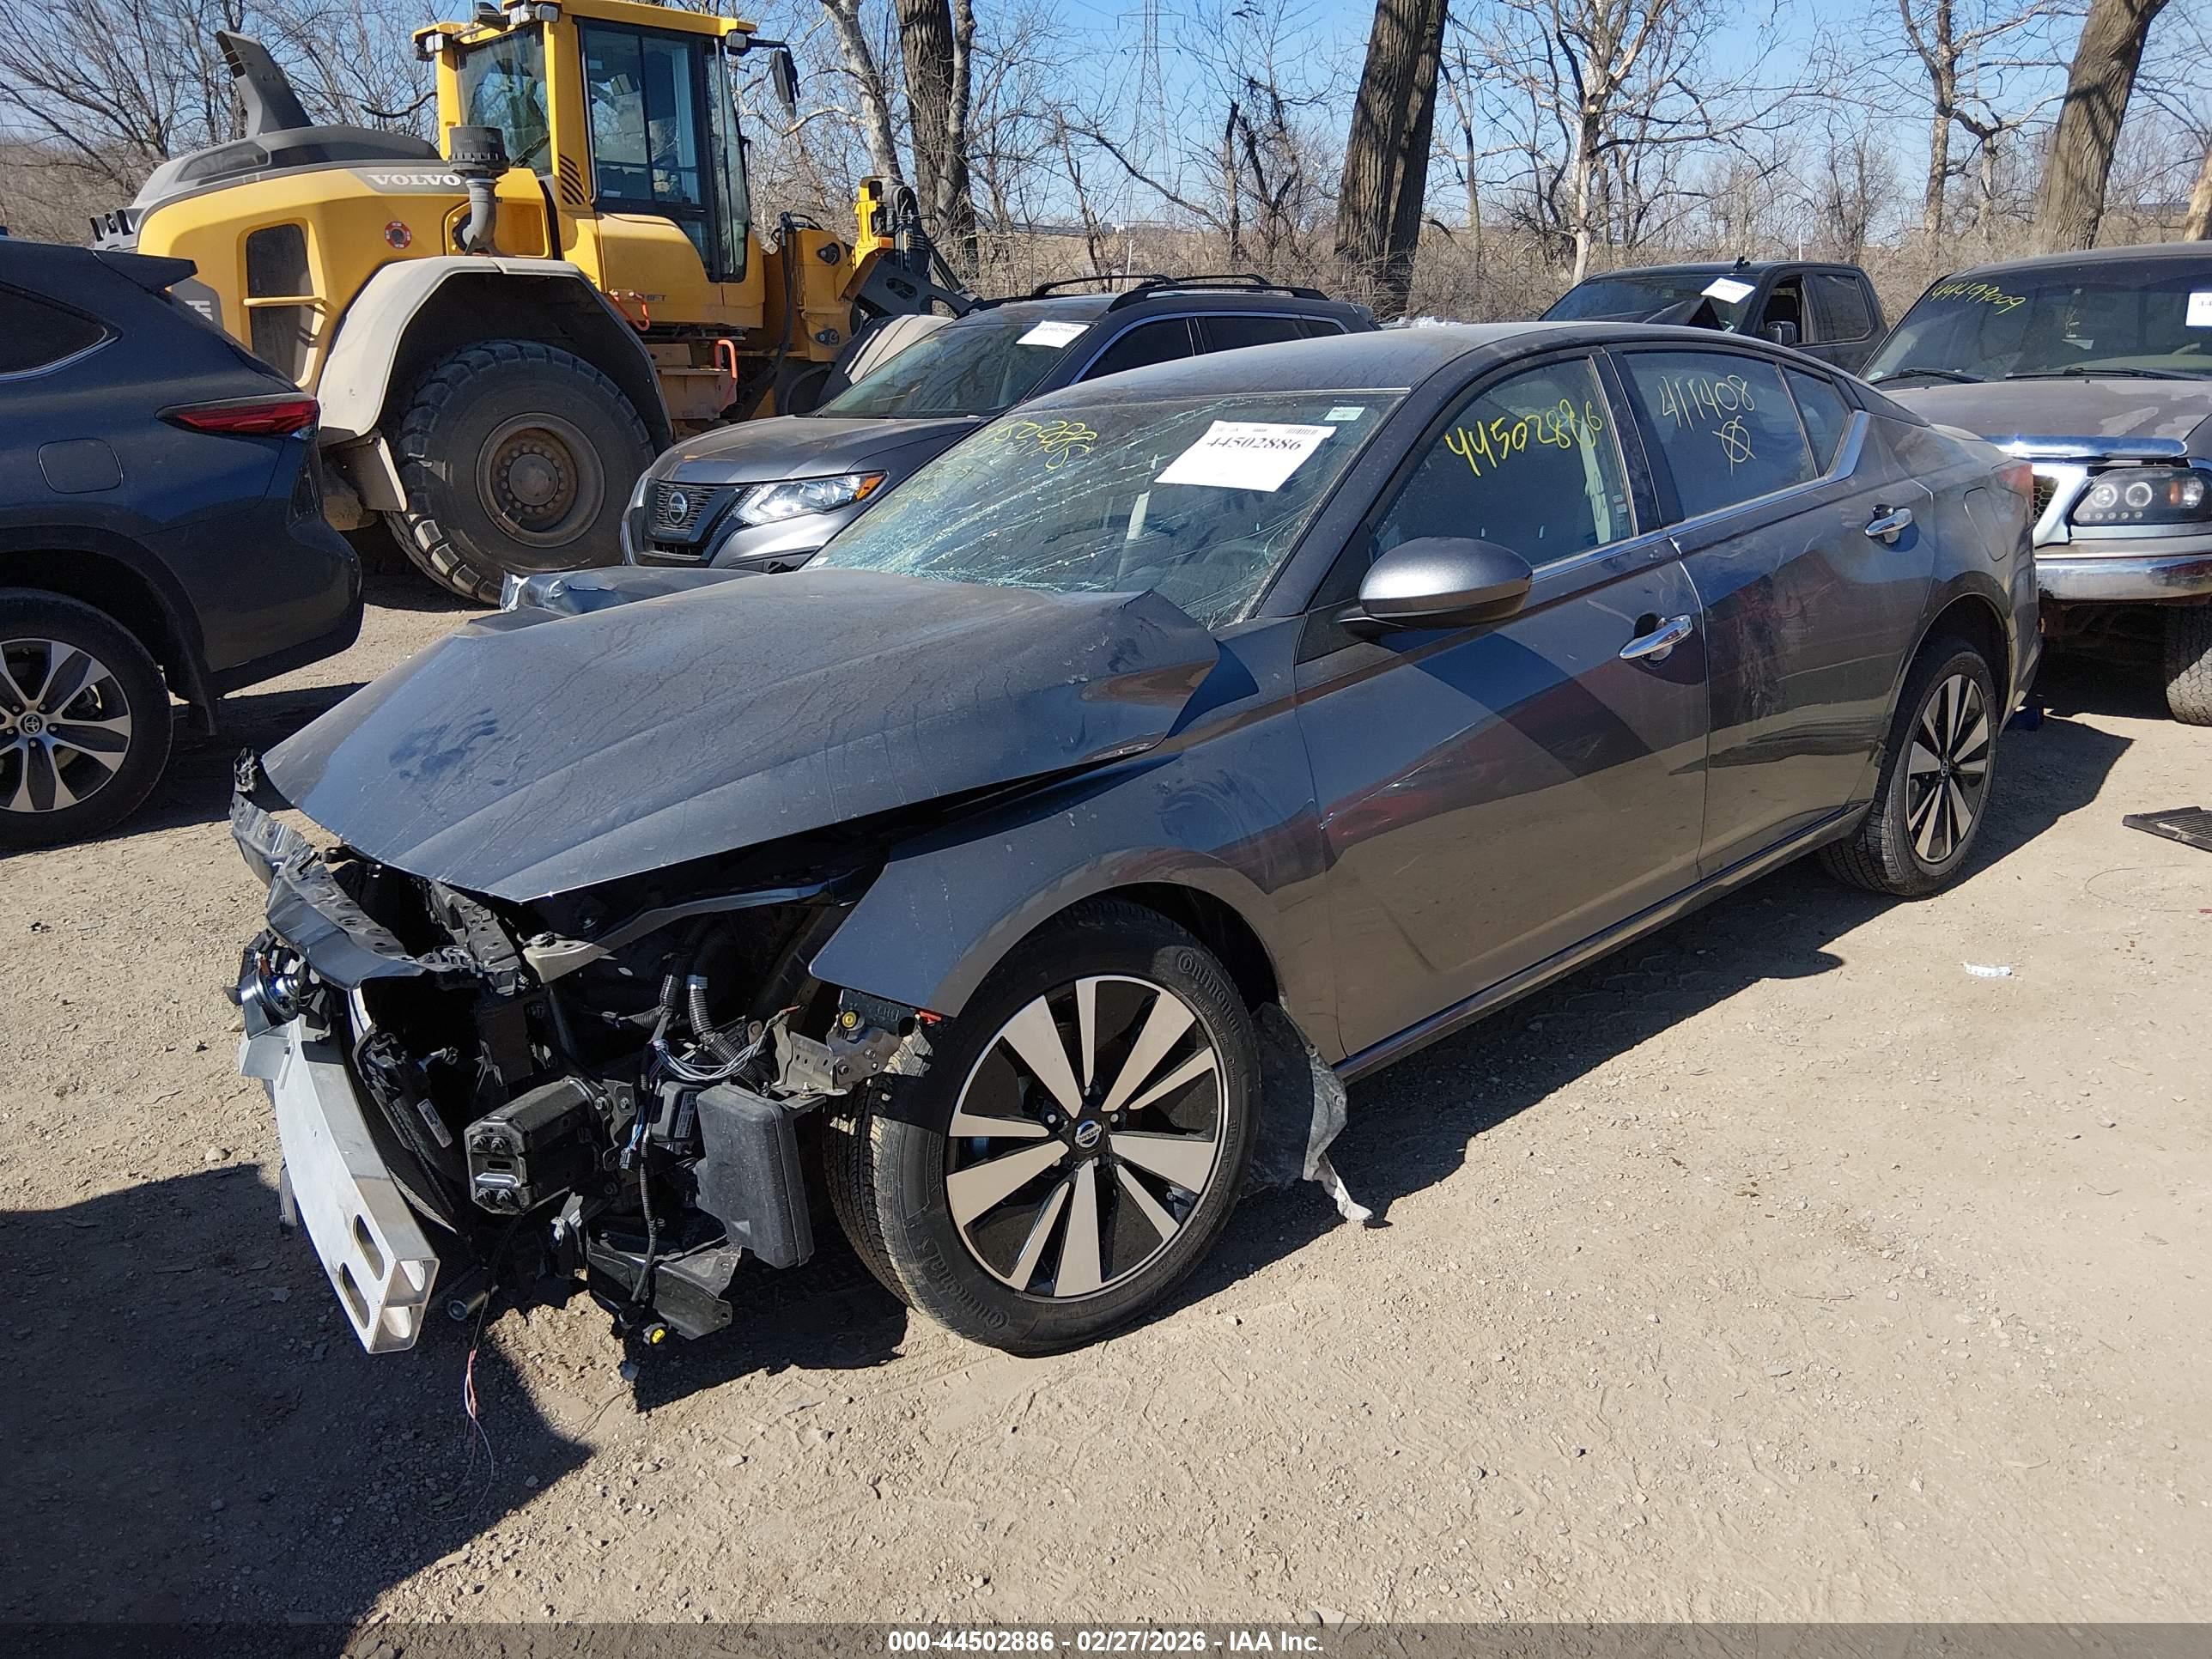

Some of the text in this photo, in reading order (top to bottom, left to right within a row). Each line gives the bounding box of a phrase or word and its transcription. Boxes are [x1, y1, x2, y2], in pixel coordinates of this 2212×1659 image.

[367, 174, 461, 186] VOLVO
[1657, 374, 1755, 432] 411408
[1206, 436, 1303, 451] 44502886
[1444, 398, 1602, 477] 44502886
